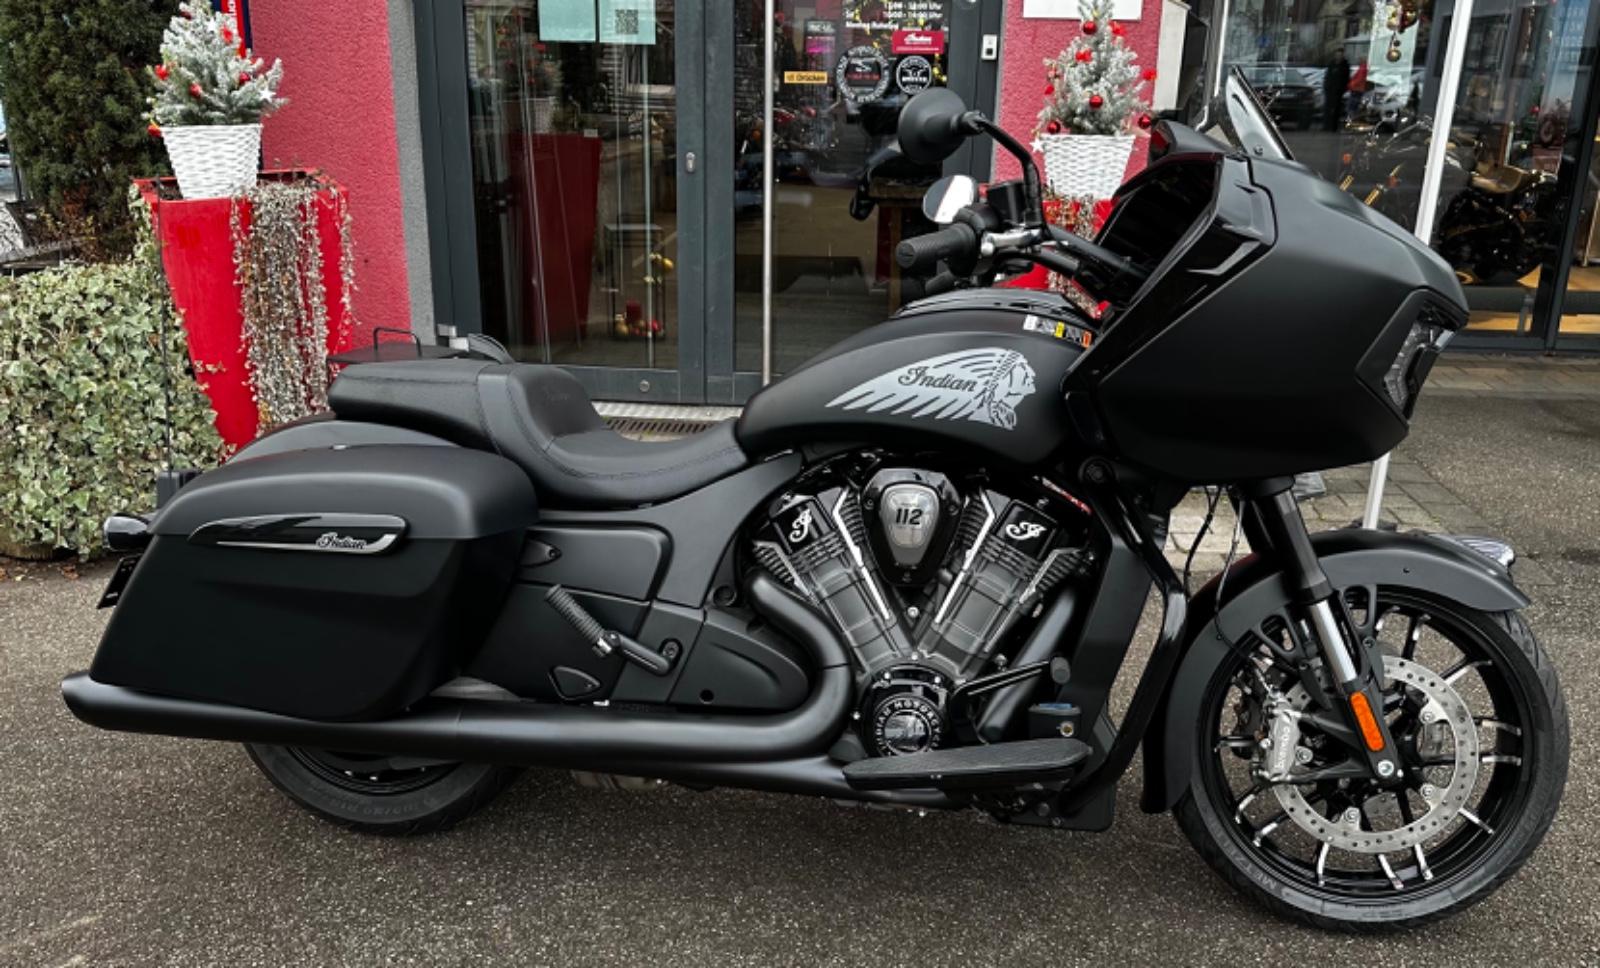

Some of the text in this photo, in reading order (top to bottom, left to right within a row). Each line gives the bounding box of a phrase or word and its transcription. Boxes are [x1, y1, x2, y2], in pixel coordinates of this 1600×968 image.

[898, 366, 978, 392] Indian
[896, 508, 922, 525] 112
[315, 531, 367, 550] Indian
